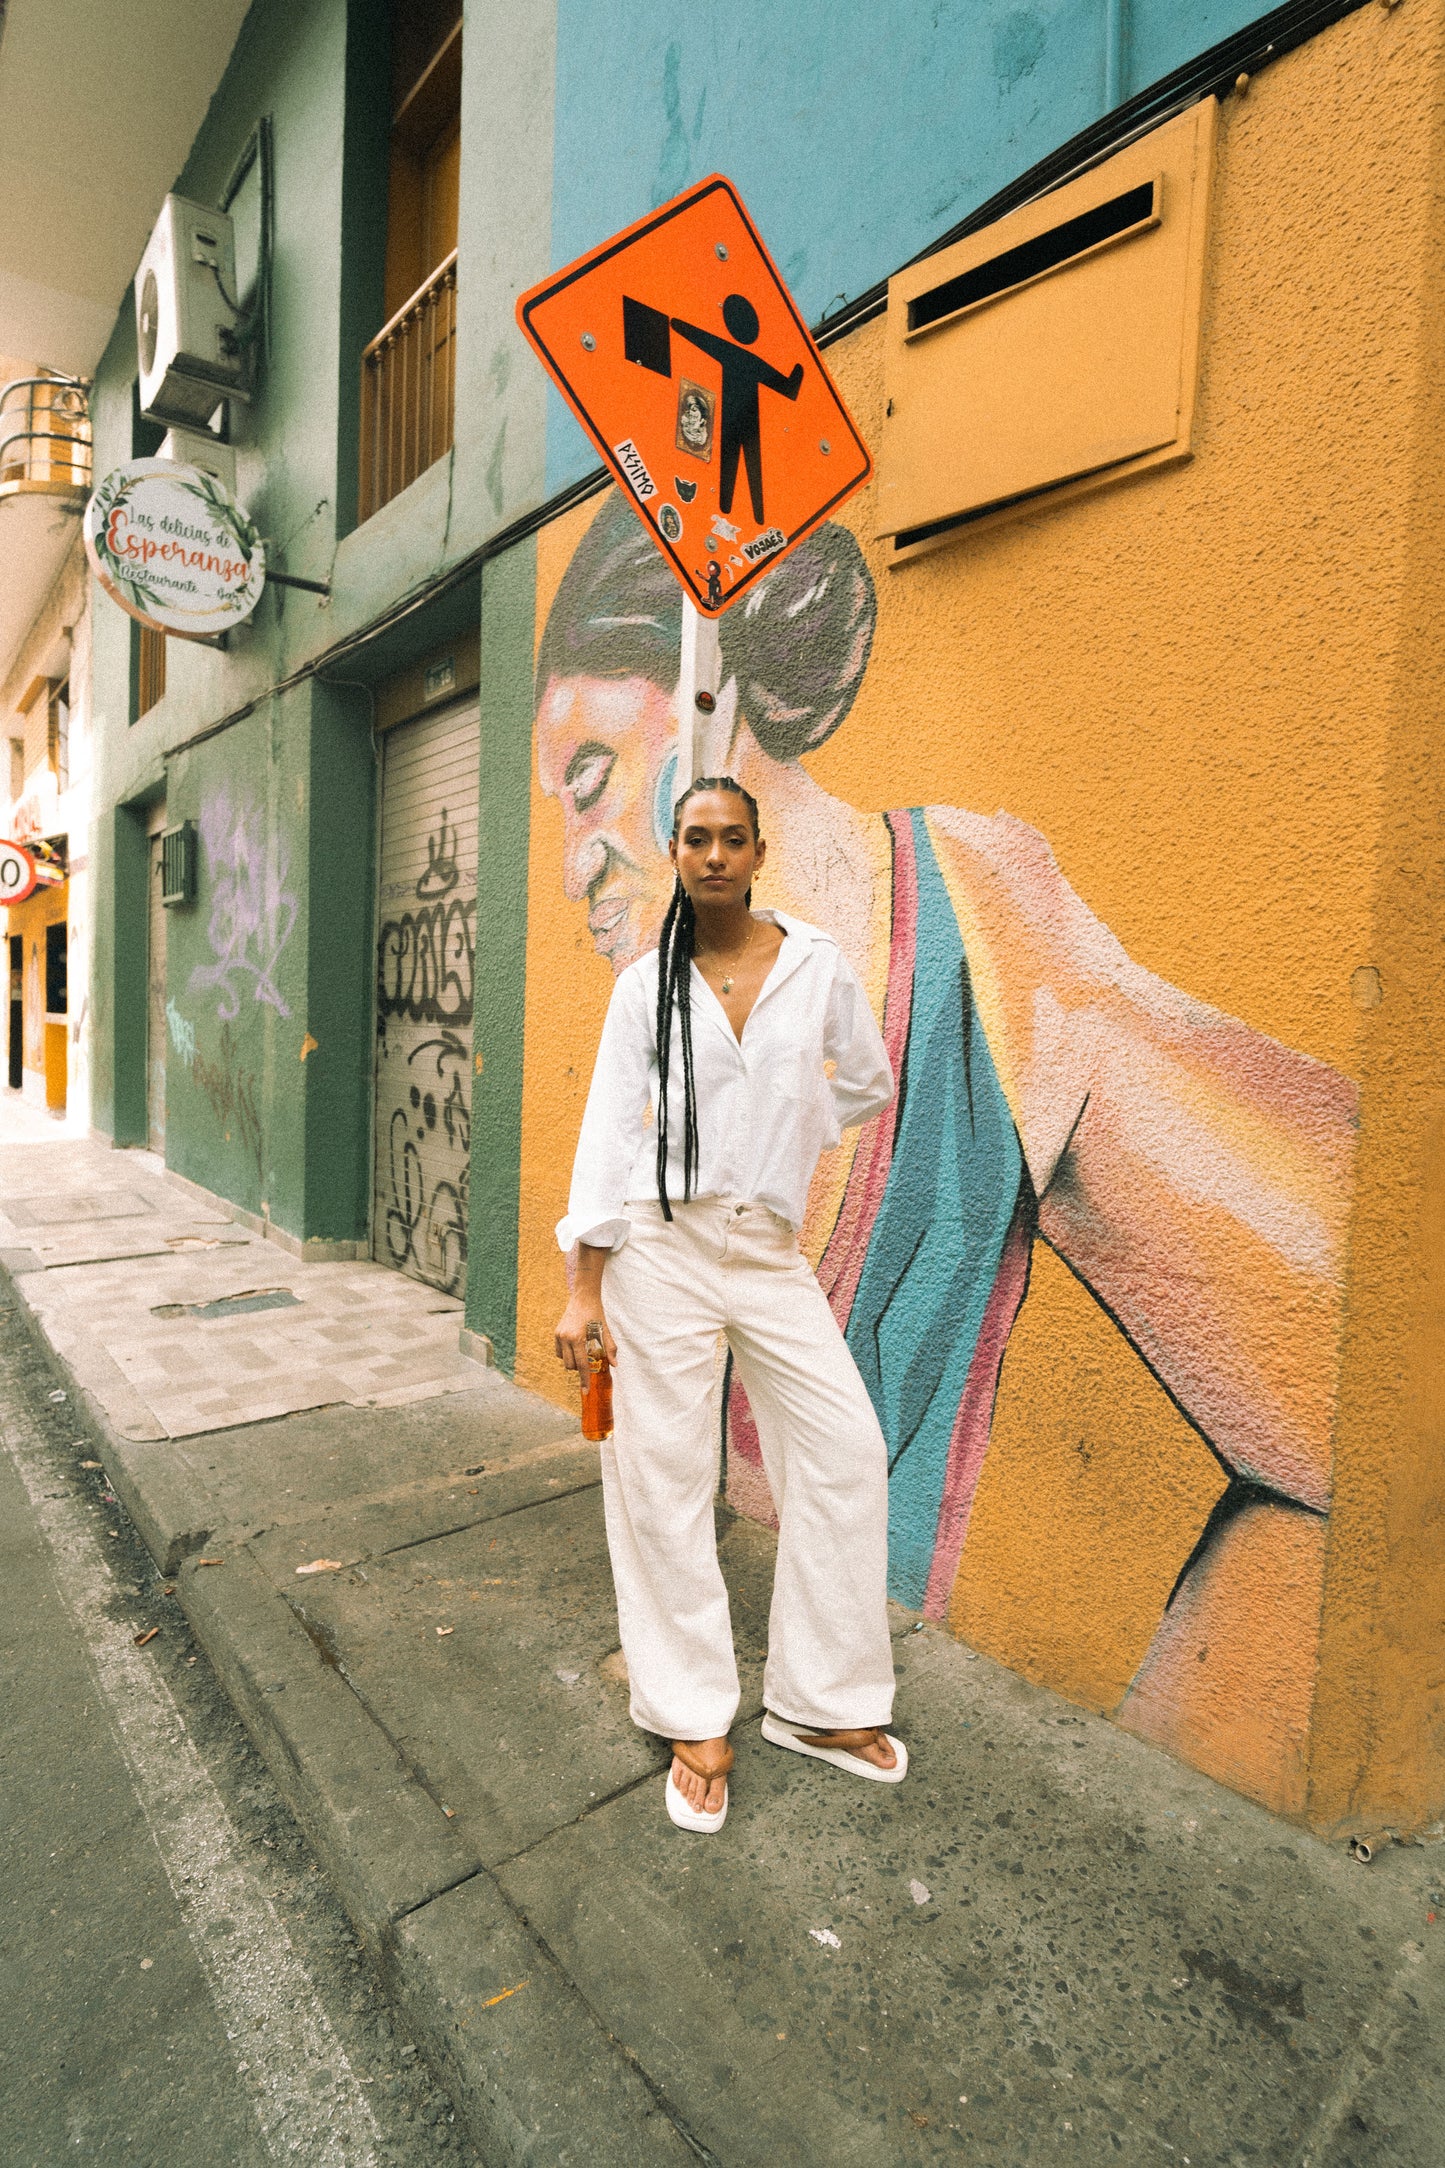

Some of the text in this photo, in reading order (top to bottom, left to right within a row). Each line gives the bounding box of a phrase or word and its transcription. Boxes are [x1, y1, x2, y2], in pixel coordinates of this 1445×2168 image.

[107, 508, 252, 583] Esperanza
[130, 505, 231, 548] Las delicias de
[120, 564, 200, 594] Restaurante
[216, 587, 238, 600] Bar
